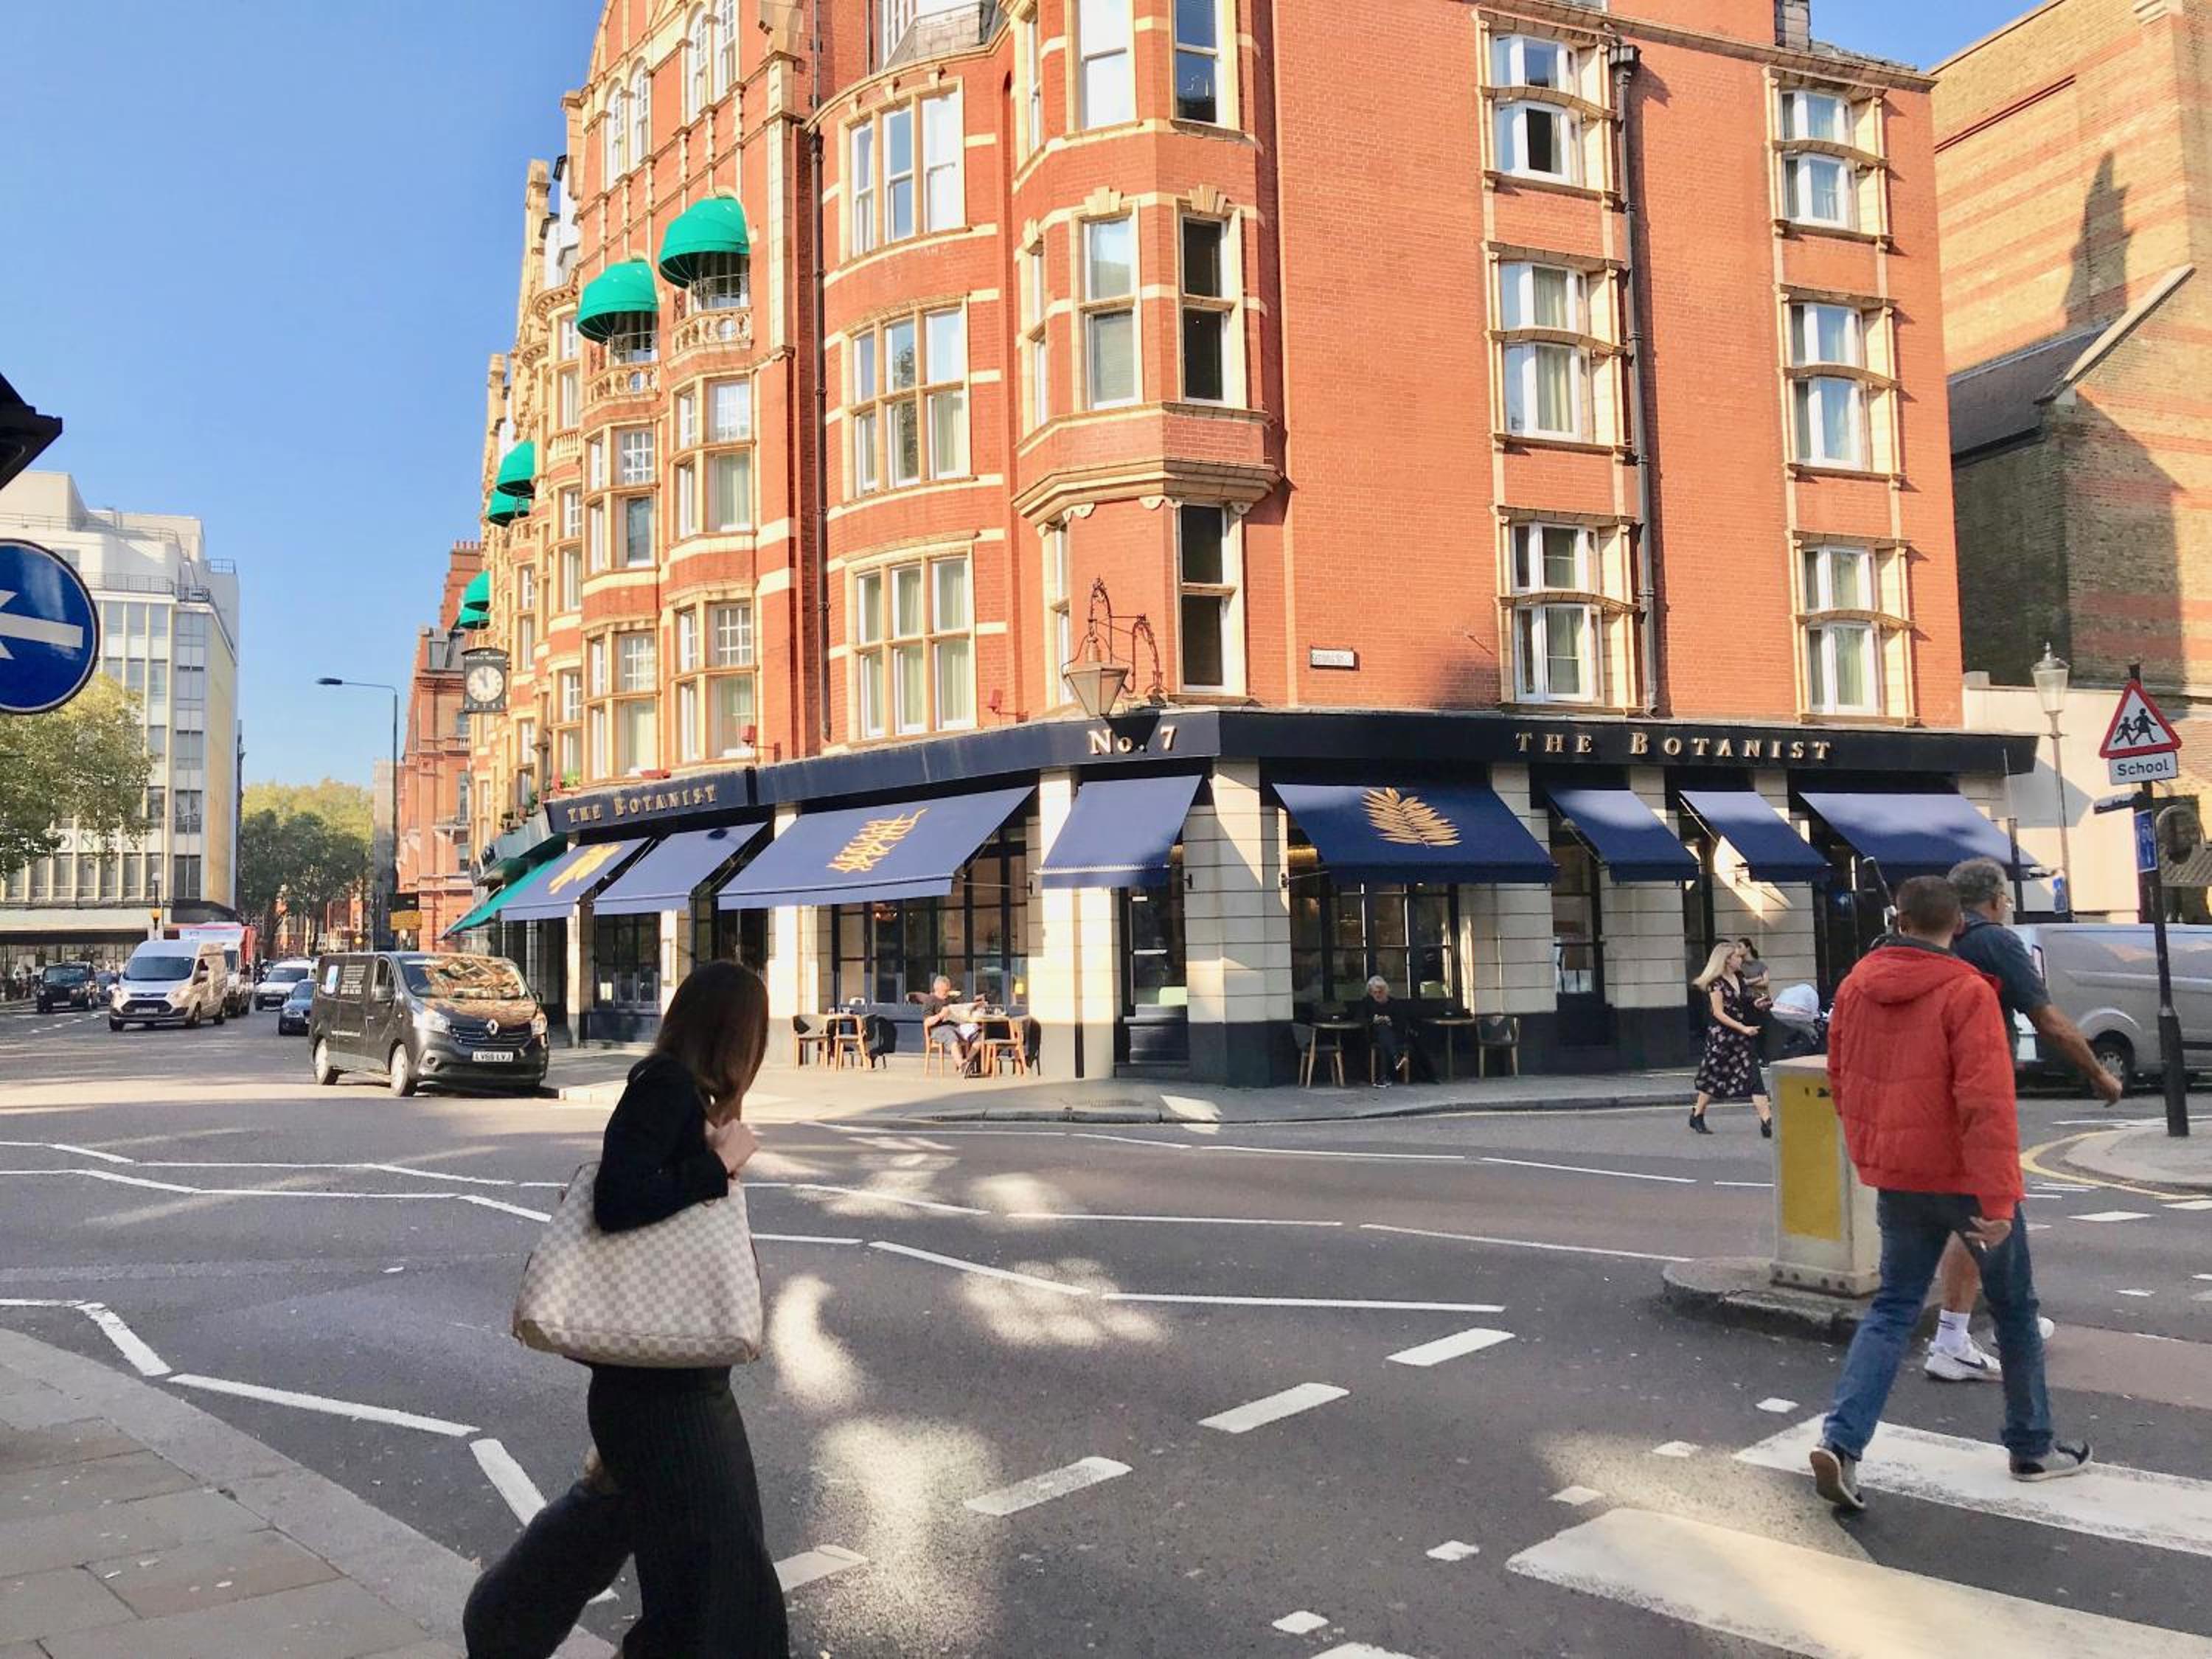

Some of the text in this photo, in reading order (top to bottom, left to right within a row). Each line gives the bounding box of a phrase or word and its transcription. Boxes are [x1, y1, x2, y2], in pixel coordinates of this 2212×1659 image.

[1088, 725, 1178, 754] No. 7
[1515, 731, 1832, 760] THE BOTANIST
[2117, 758, 2170, 776] School
[567, 784, 717, 824] THE BOTANIST
